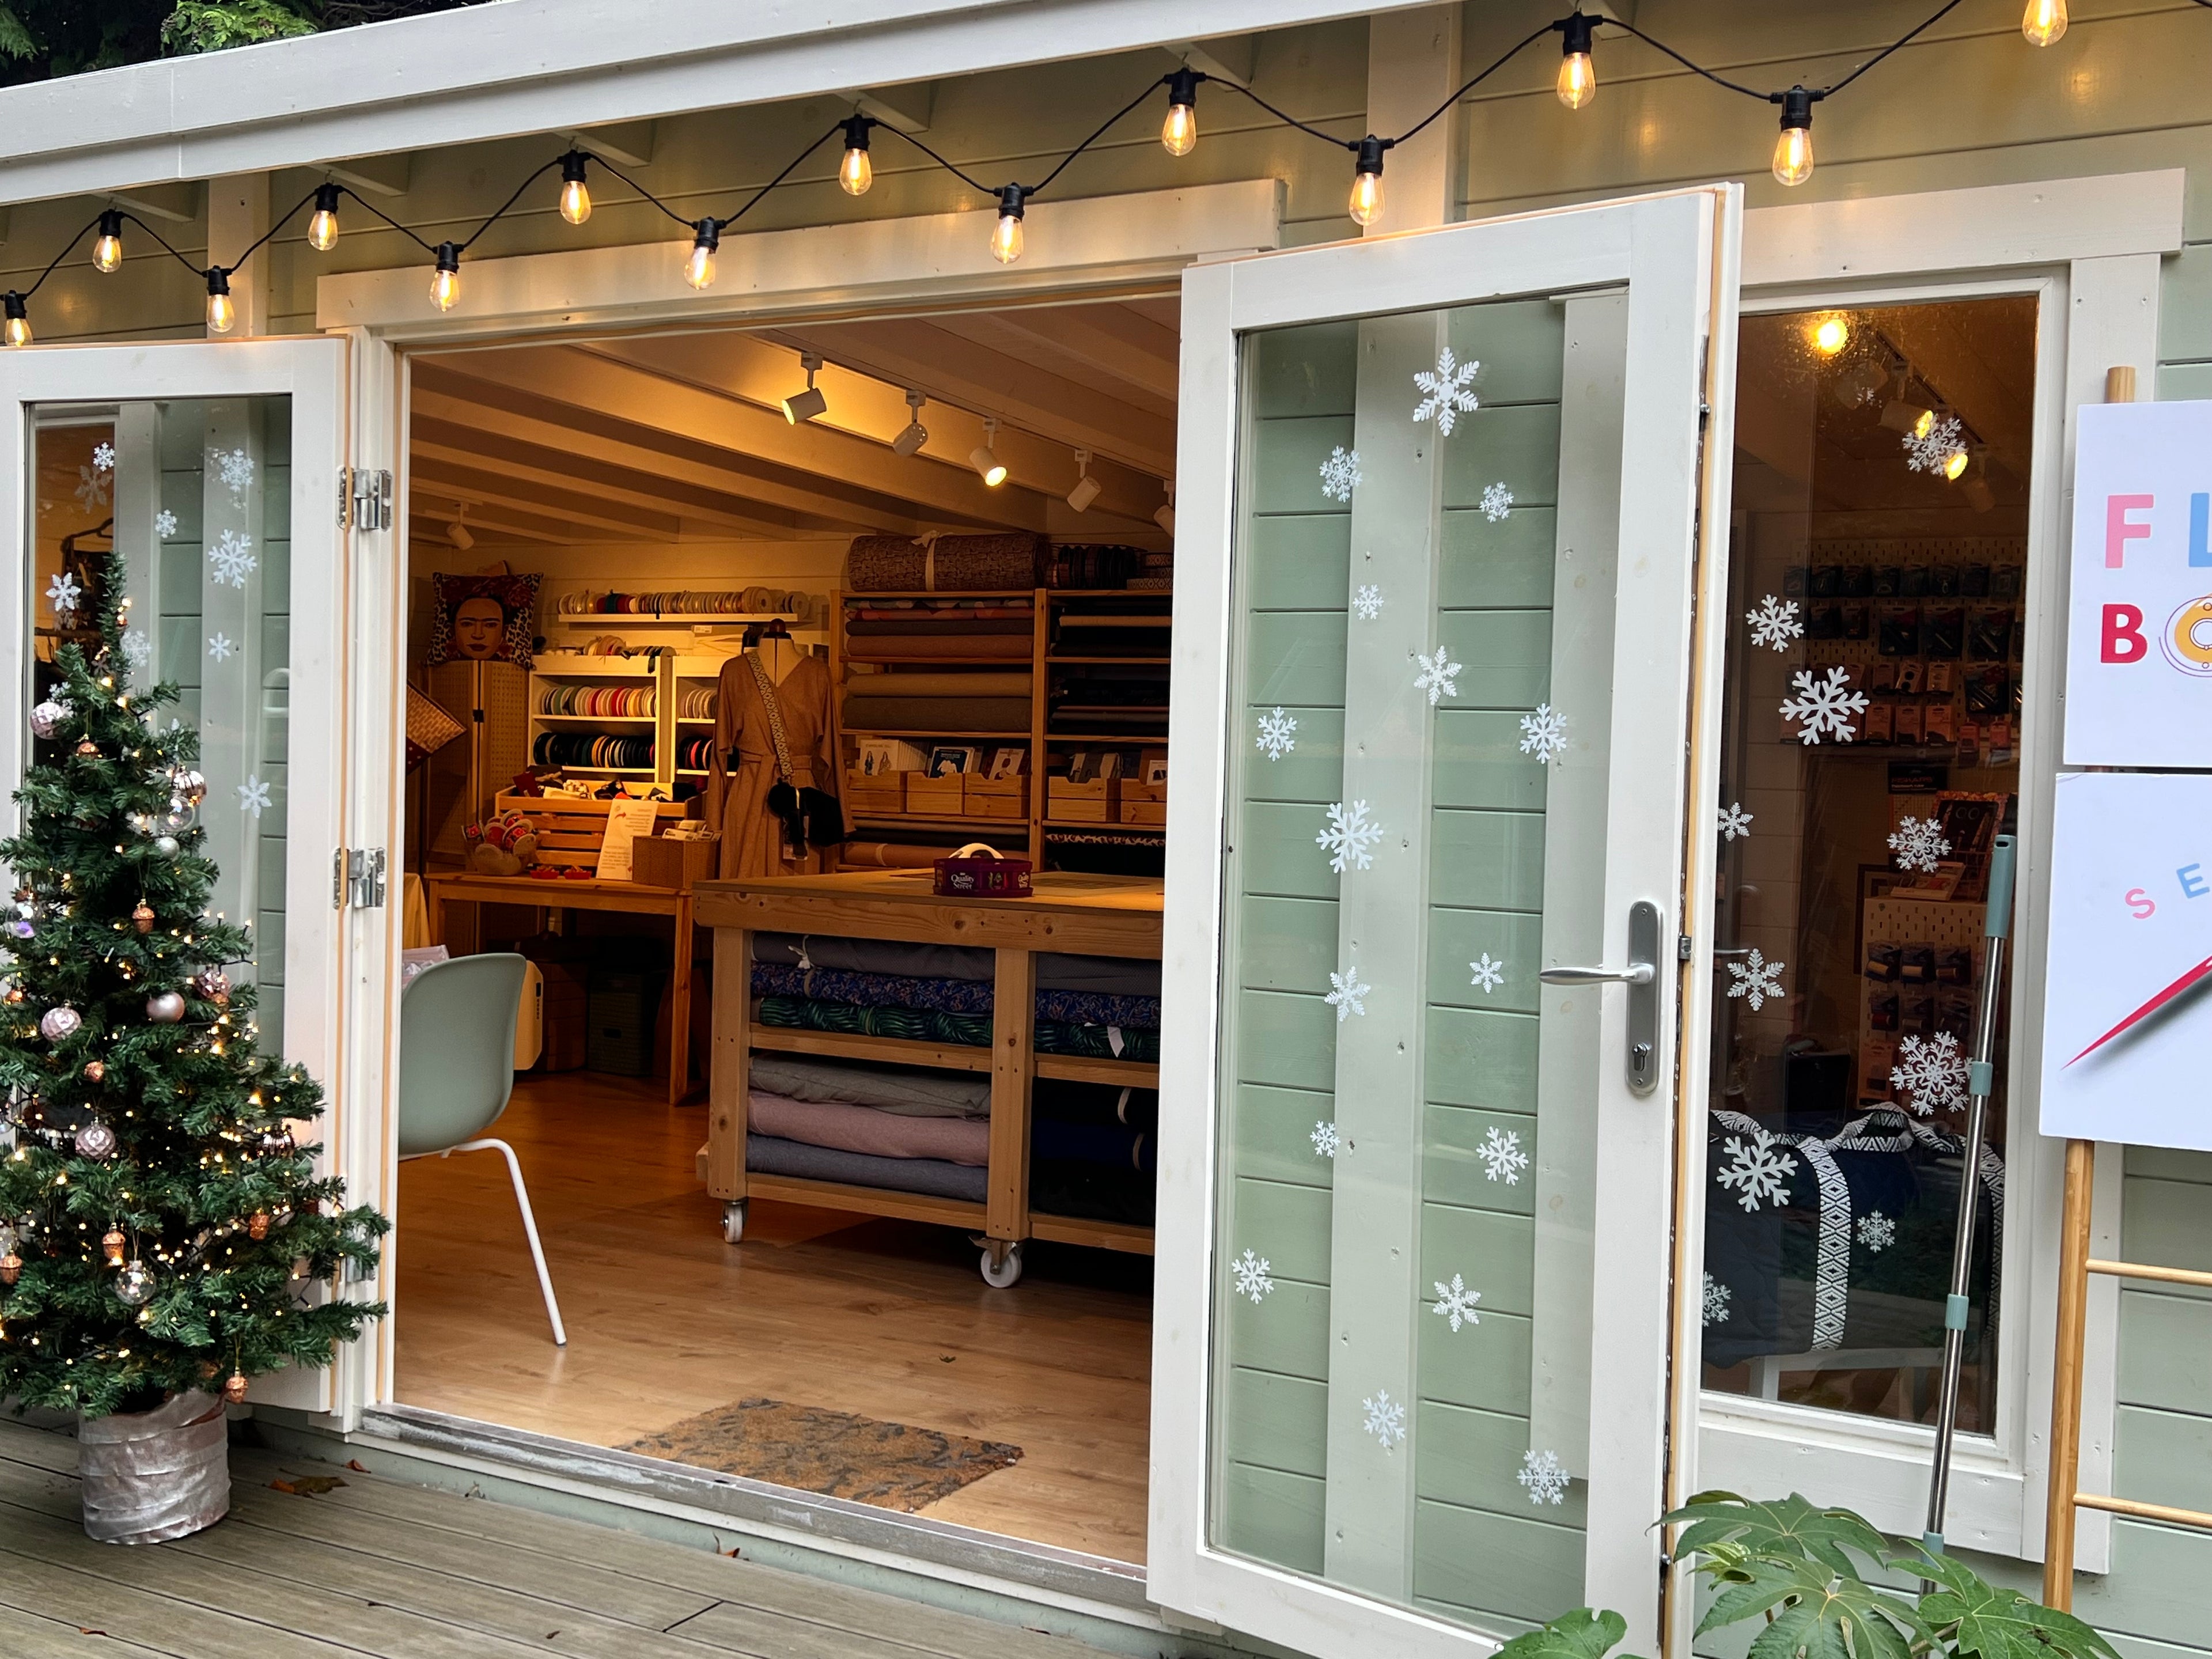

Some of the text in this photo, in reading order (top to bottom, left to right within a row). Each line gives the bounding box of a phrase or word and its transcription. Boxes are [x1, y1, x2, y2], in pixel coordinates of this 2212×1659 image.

[2105, 493, 2212, 569] FL
[951, 874, 974, 885] Quality
[2125, 863, 2210, 919] SE
